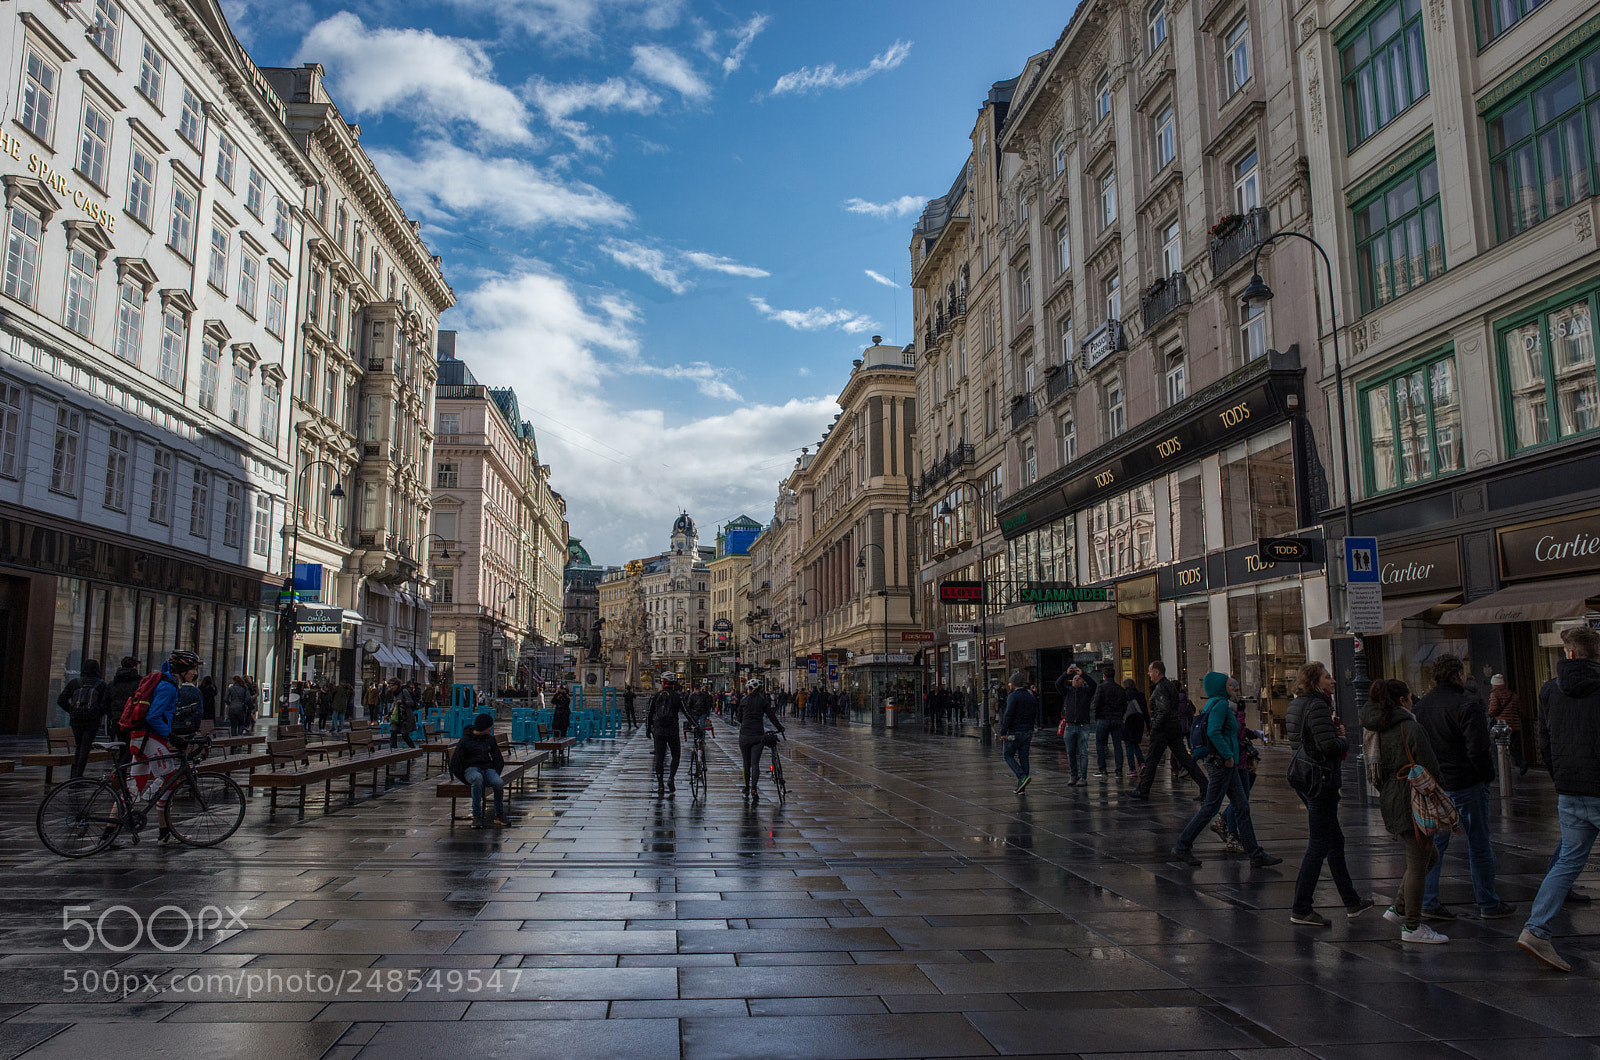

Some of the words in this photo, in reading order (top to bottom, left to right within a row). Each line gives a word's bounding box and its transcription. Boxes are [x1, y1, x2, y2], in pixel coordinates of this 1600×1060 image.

[28, 153, 116, 234] SPAR-CASSE
[1091, 335, 1108, 354] PENSIO
[1219, 402, 1250, 429] TOD'S
[1156, 436, 1182, 459] TOD'S
[1094, 469, 1114, 489] TOD'S
[1273, 545, 1298, 556] TOD'S
[1178, 567, 1202, 586] TOD'S
[1381, 562, 1434, 585] Cartier
[1022, 588, 1107, 601] SALAMANDER
[1495, 608, 1522, 620] Cartier
[300, 625, 316, 633] VON
[316, 623, 338, 633] KÖCK
